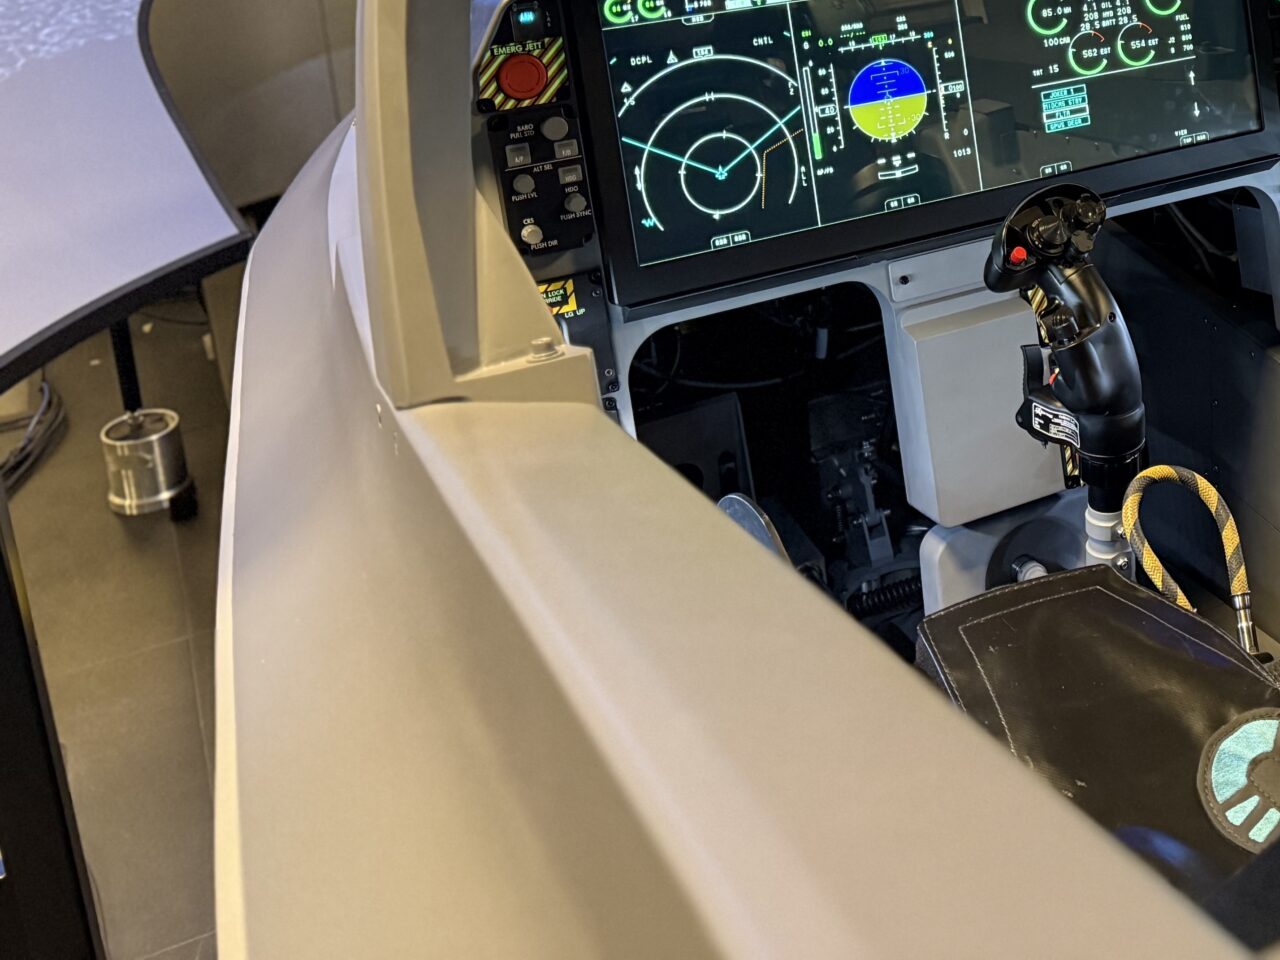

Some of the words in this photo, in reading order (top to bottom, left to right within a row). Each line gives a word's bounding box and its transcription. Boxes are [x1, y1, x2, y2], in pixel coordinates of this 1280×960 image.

[1042, 6, 1062, 18] 85.0
[1084, 12, 1099, 22] 208
[1116, 6, 1132, 15] 208
[1080, 21, 1100, 32] 28.5
[1118, 14, 1138, 25] 28.5
[1176, 14, 1190, 22] FUEL
[753, 36, 774, 46] CNTL
[1043, 38, 1058, 48] 100
[494, 44, 523, 56] EMERG
[524, 42, 542, 51] JETT
[630, 55, 652, 66] DCPL
[1048, 64, 1060, 74] 15
[1050, 89, 1068, 98] JOKER
[954, 147, 972, 158] 1013
[512, 194, 527, 202] PUSH
[560, 212, 576, 221] PUSH
[576, 210, 592, 218] SYNC
[530, 242, 548, 250] PUSH
[548, 288, 565, 298] LOCK
[576, 308, 586, 316] UP
